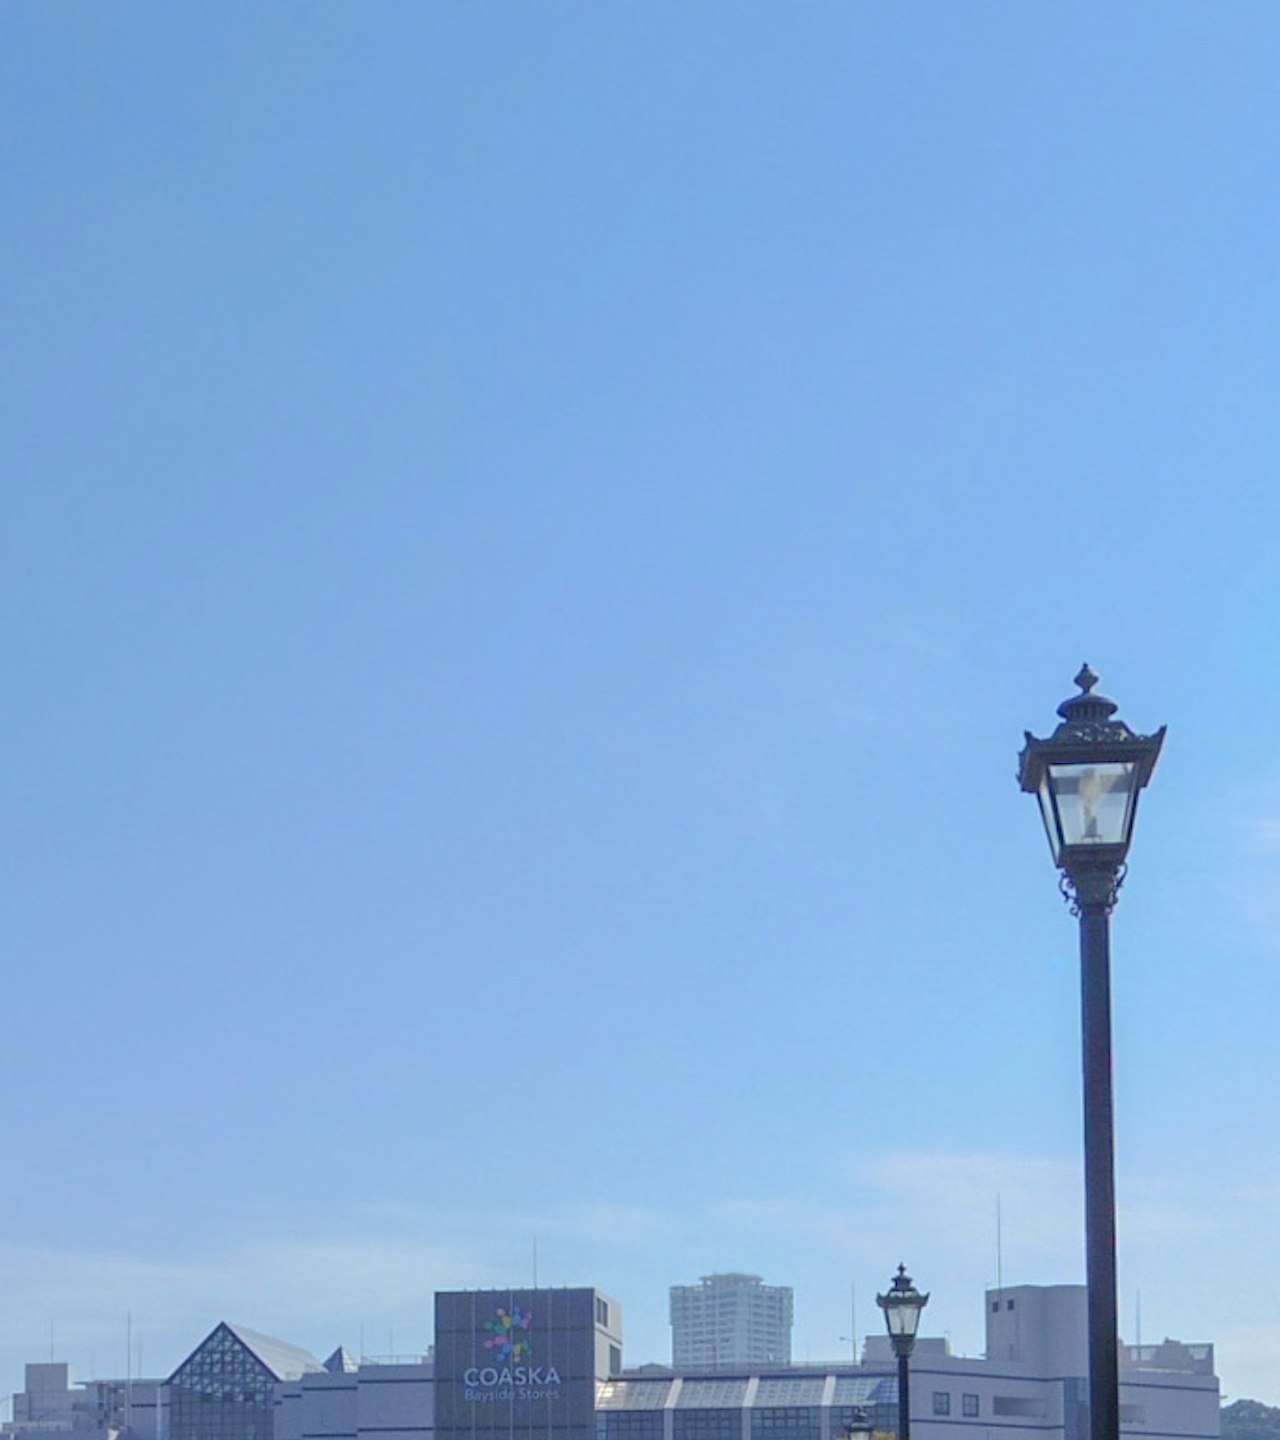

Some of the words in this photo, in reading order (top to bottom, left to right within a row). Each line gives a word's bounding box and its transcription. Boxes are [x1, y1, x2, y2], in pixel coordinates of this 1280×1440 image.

[464, 1367, 560, 1386] COASKA
[465, 1388, 515, 1402] Bayside
[519, 1387, 559, 1400] Stores
